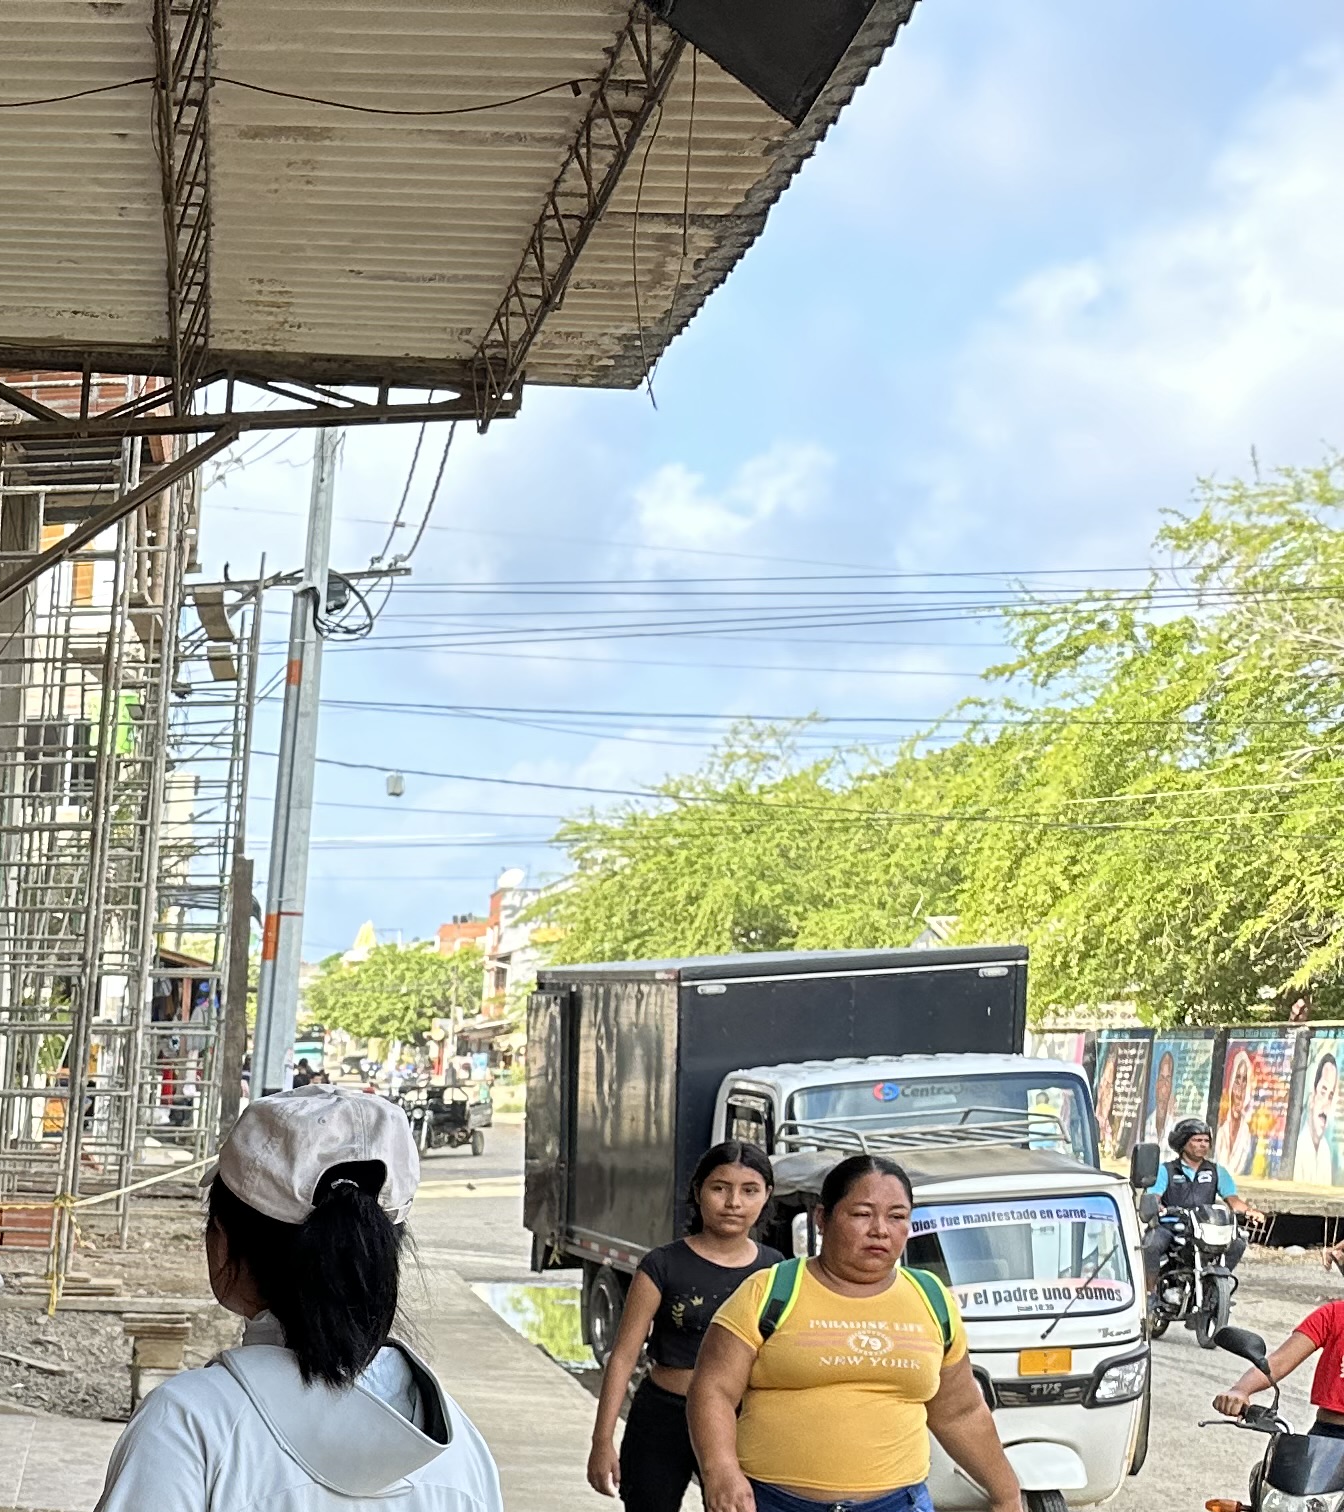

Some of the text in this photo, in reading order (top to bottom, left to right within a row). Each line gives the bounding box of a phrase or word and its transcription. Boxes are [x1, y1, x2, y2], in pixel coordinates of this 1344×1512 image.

[911, 1207, 1087, 1233] Dios fue manifestado en carne
[958, 1286, 1123, 1309] y el padre uno somos
[809, 1319, 890, 1331] PARADISE
[857, 1334, 882, 1351] 79
[818, 1355, 921, 1370] NEW YORK
[1030, 1383, 1062, 1396] TVS
